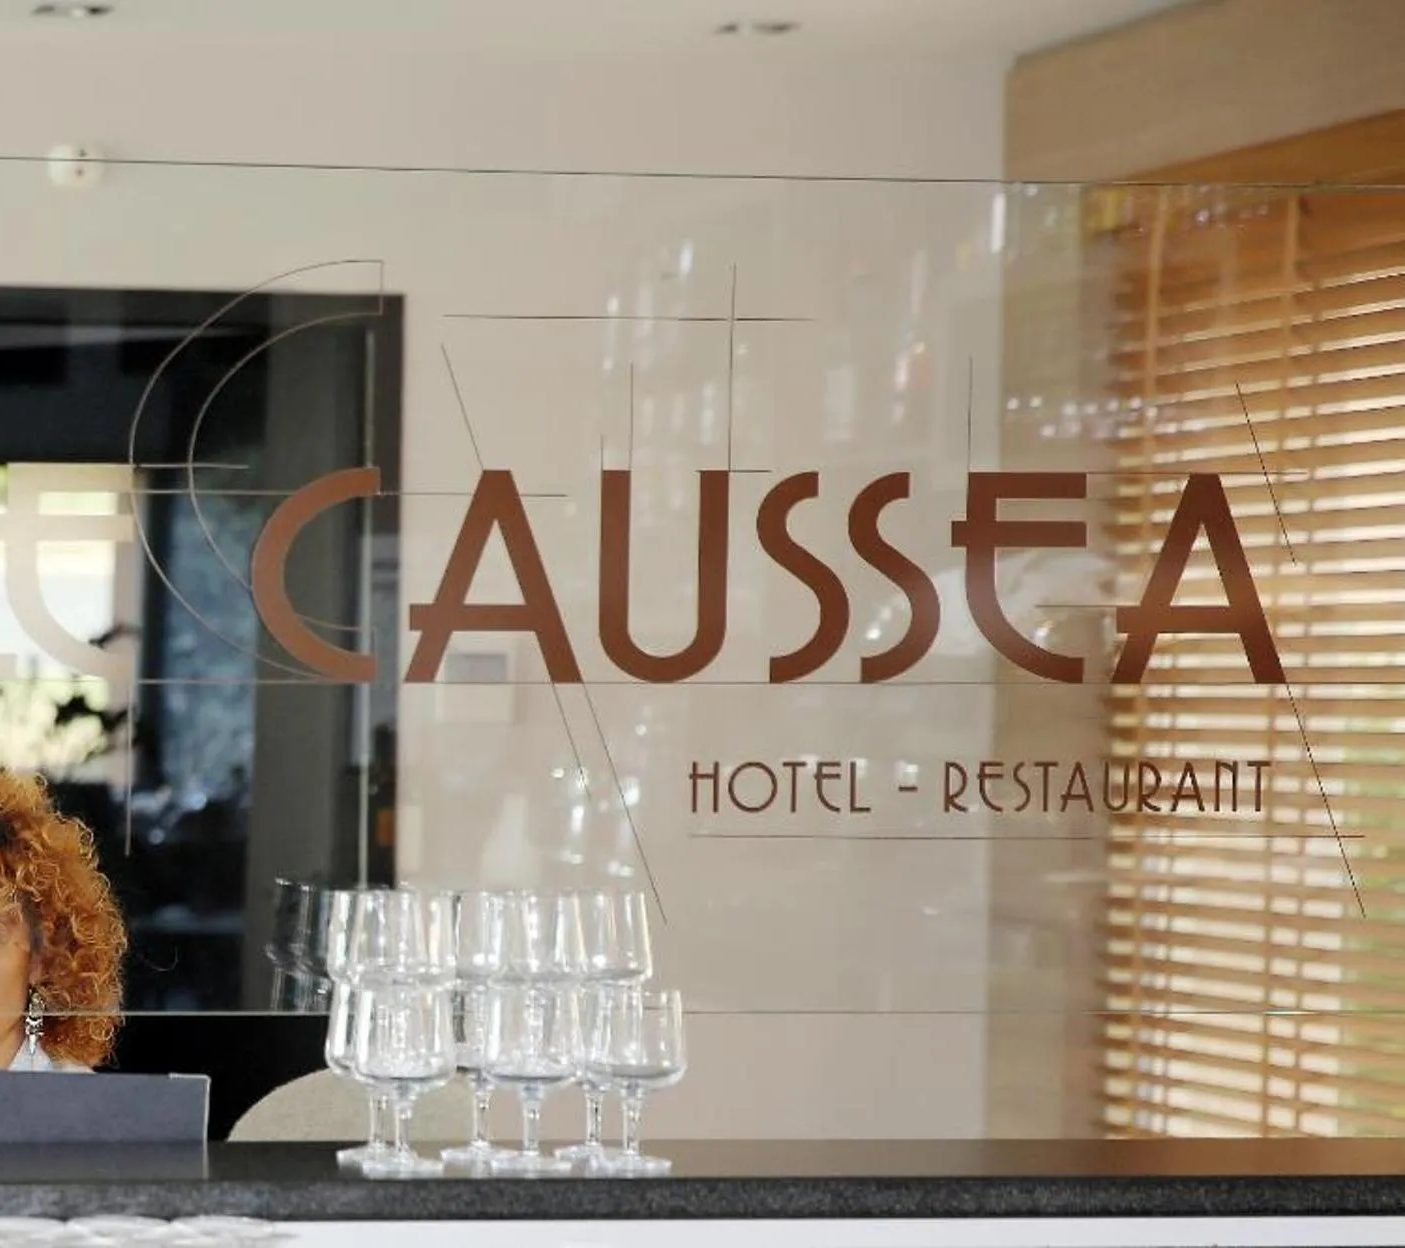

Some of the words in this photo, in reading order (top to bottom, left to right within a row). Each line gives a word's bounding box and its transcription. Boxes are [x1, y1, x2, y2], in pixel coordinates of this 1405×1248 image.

[252, 467, 1287, 684] CAUSSEA
[689, 761, 872, 813] HOTEL
[943, 761, 1272, 813] RESTAURANT
